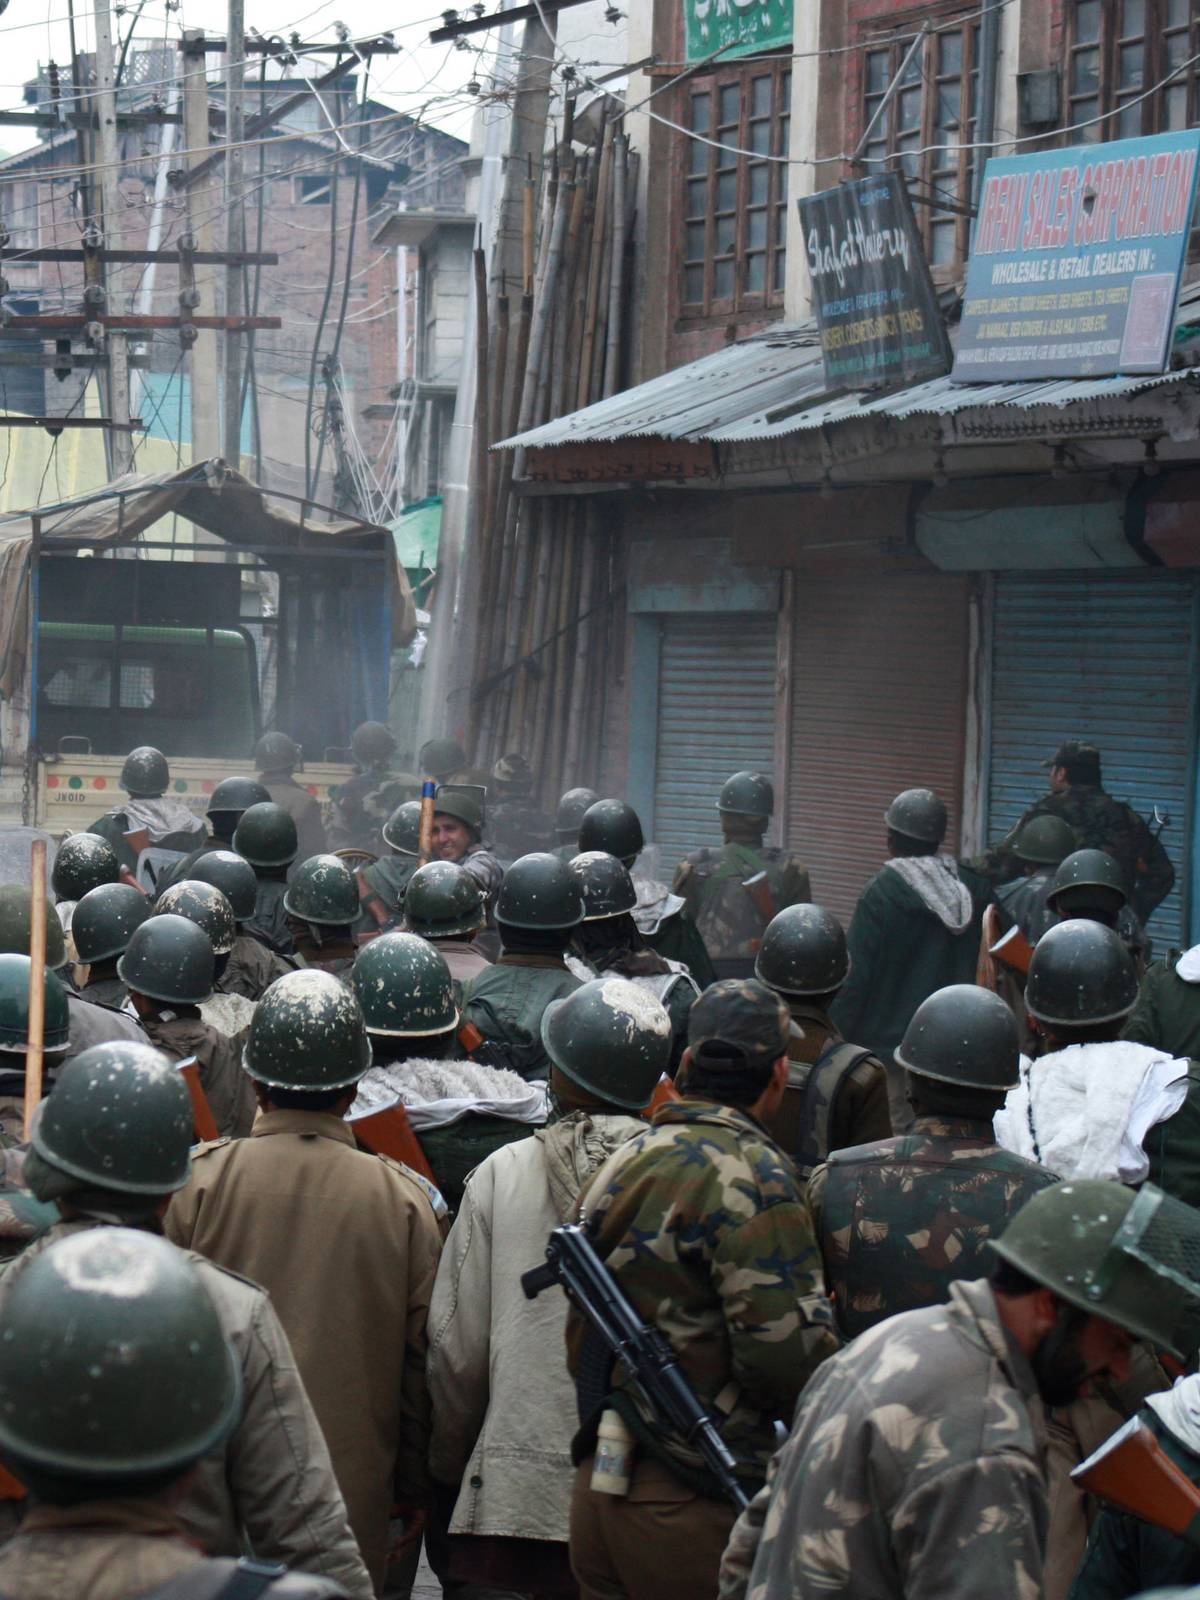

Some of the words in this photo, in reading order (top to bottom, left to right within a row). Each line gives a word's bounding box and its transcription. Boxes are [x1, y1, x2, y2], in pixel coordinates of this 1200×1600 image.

[975, 172, 1030, 256] IRFAN
[1023, 164, 1079, 251] SALES
[1073, 148, 1197, 247] CORPORATION
[991, 259, 1049, 285] WHOLESALE
[1049, 260, 1057, 281] &
[1058, 255, 1090, 280] RETAIL
[1092, 252, 1136, 277] DEALERS
